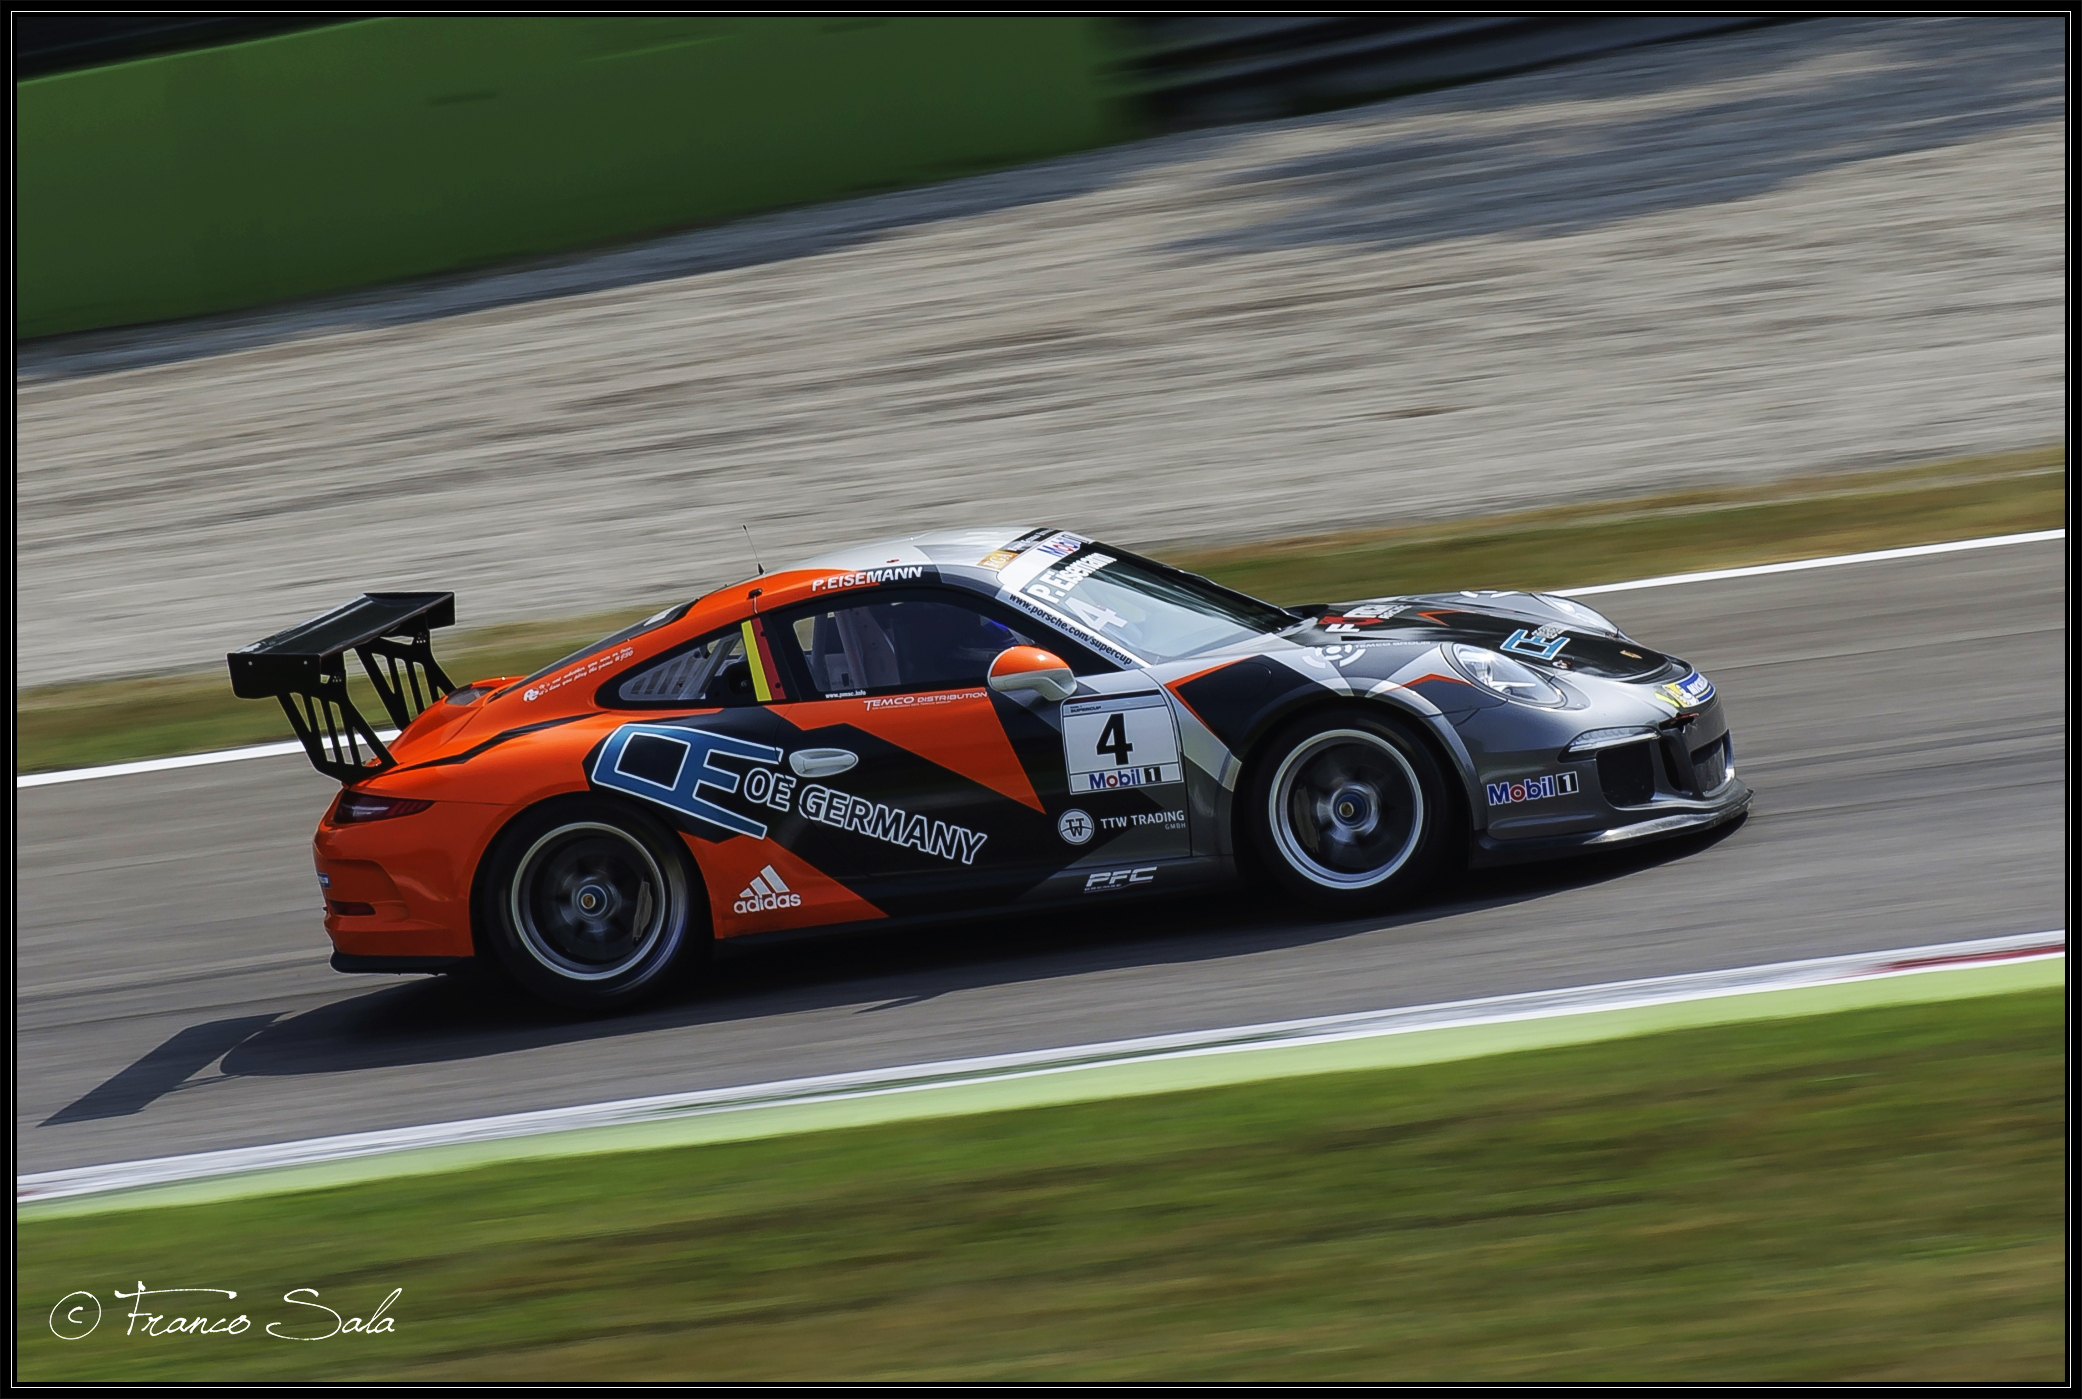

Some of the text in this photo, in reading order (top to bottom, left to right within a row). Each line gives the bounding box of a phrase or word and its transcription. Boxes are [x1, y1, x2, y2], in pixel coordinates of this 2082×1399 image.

[812, 566, 923, 592] P.EISEMANN
[1065, 596, 1129, 632] 4
[1008, 593, 1133, 666] www.porsche.com/supercup
[863, 691, 988, 711] TEMCO DISTRIBUTION
[1096, 713, 1133, 766] 4
[1089, 768, 1141, 790] Mobil
[1486, 775, 1555, 807] Mobil
[743, 767, 987, 865] OE GERMANY
[1100, 810, 1185, 829] TTW TRADING
[1164, 822, 1186, 830] GMBH
[1085, 866, 1158, 887] PFC
[733, 891, 802, 915] adidas
